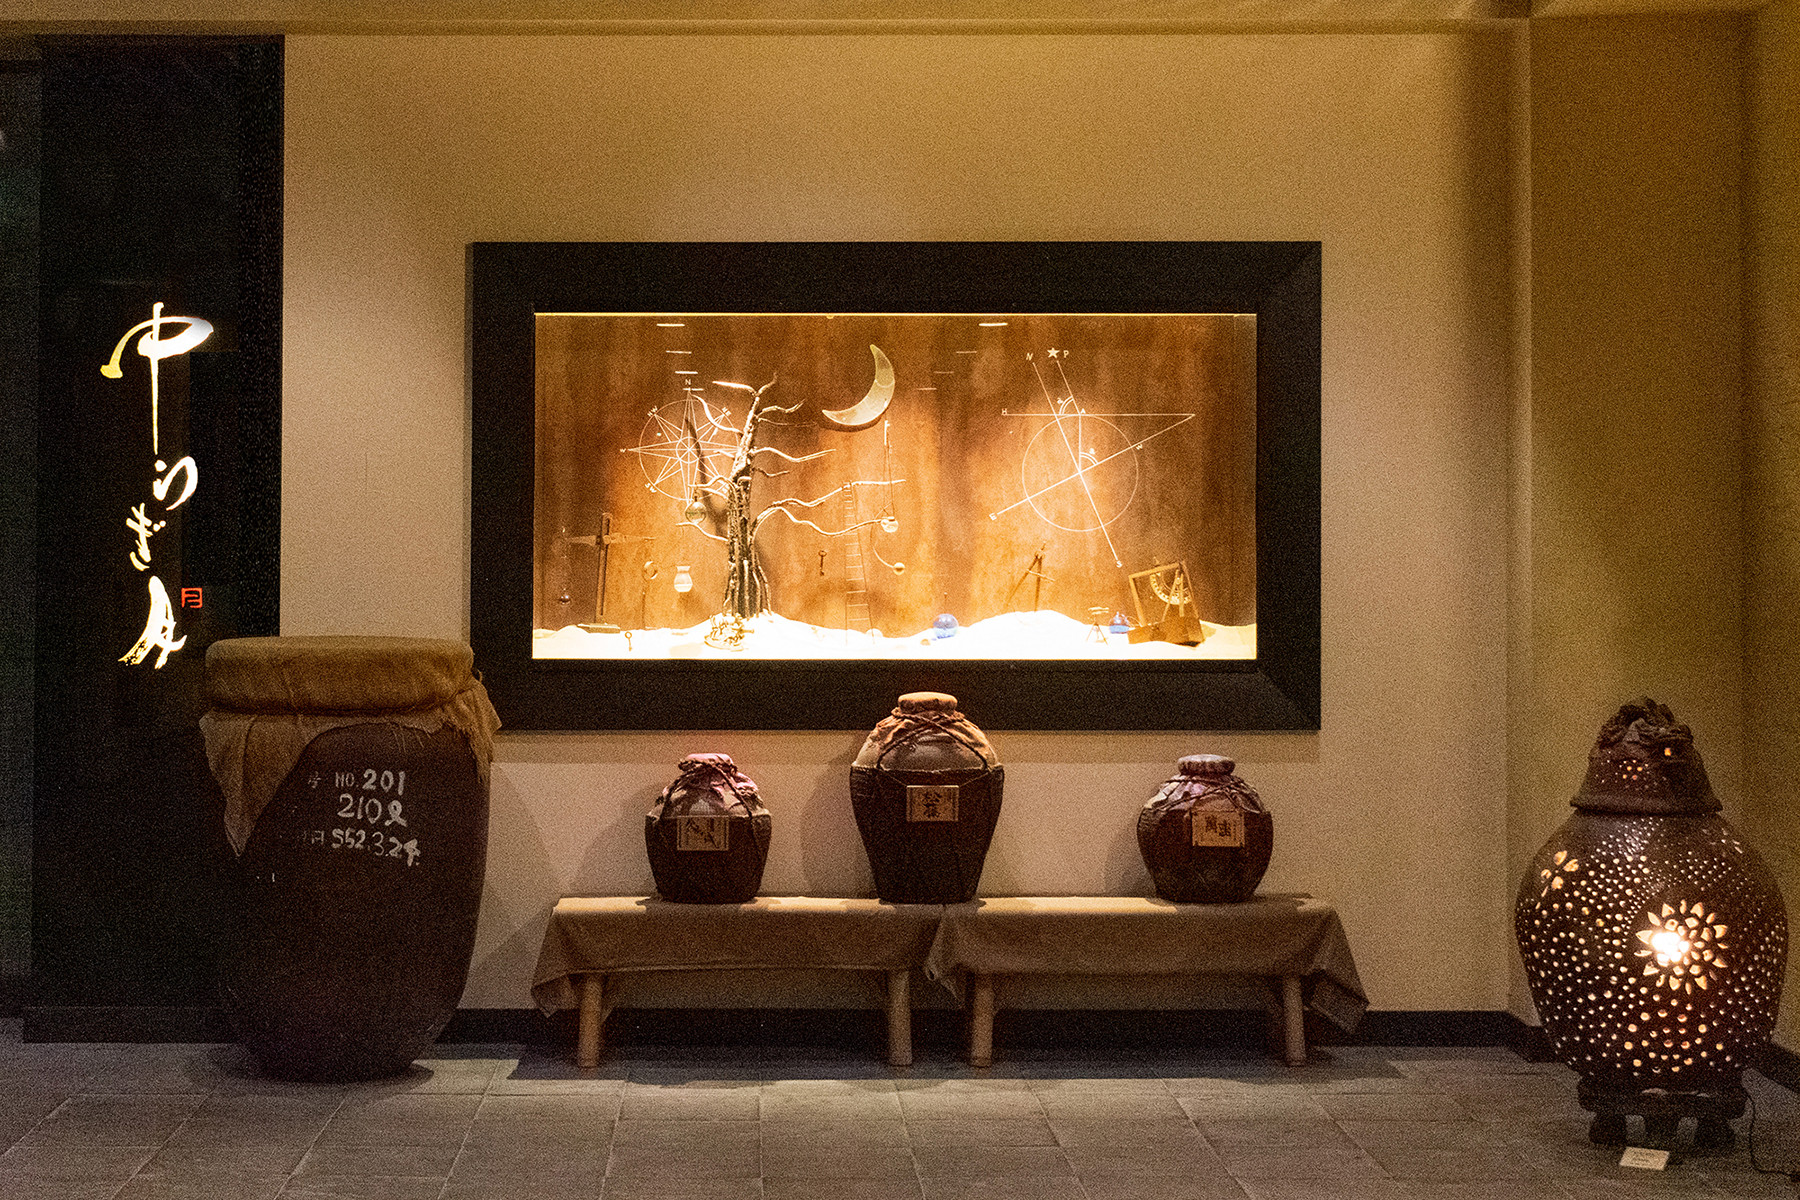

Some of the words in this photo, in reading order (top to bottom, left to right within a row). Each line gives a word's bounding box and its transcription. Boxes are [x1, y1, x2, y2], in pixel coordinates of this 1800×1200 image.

[1025, 352, 1034, 361] N
[1062, 349, 1070, 359] P
[684, 378, 692, 386] N
[1115, 559, 1123, 569] S
